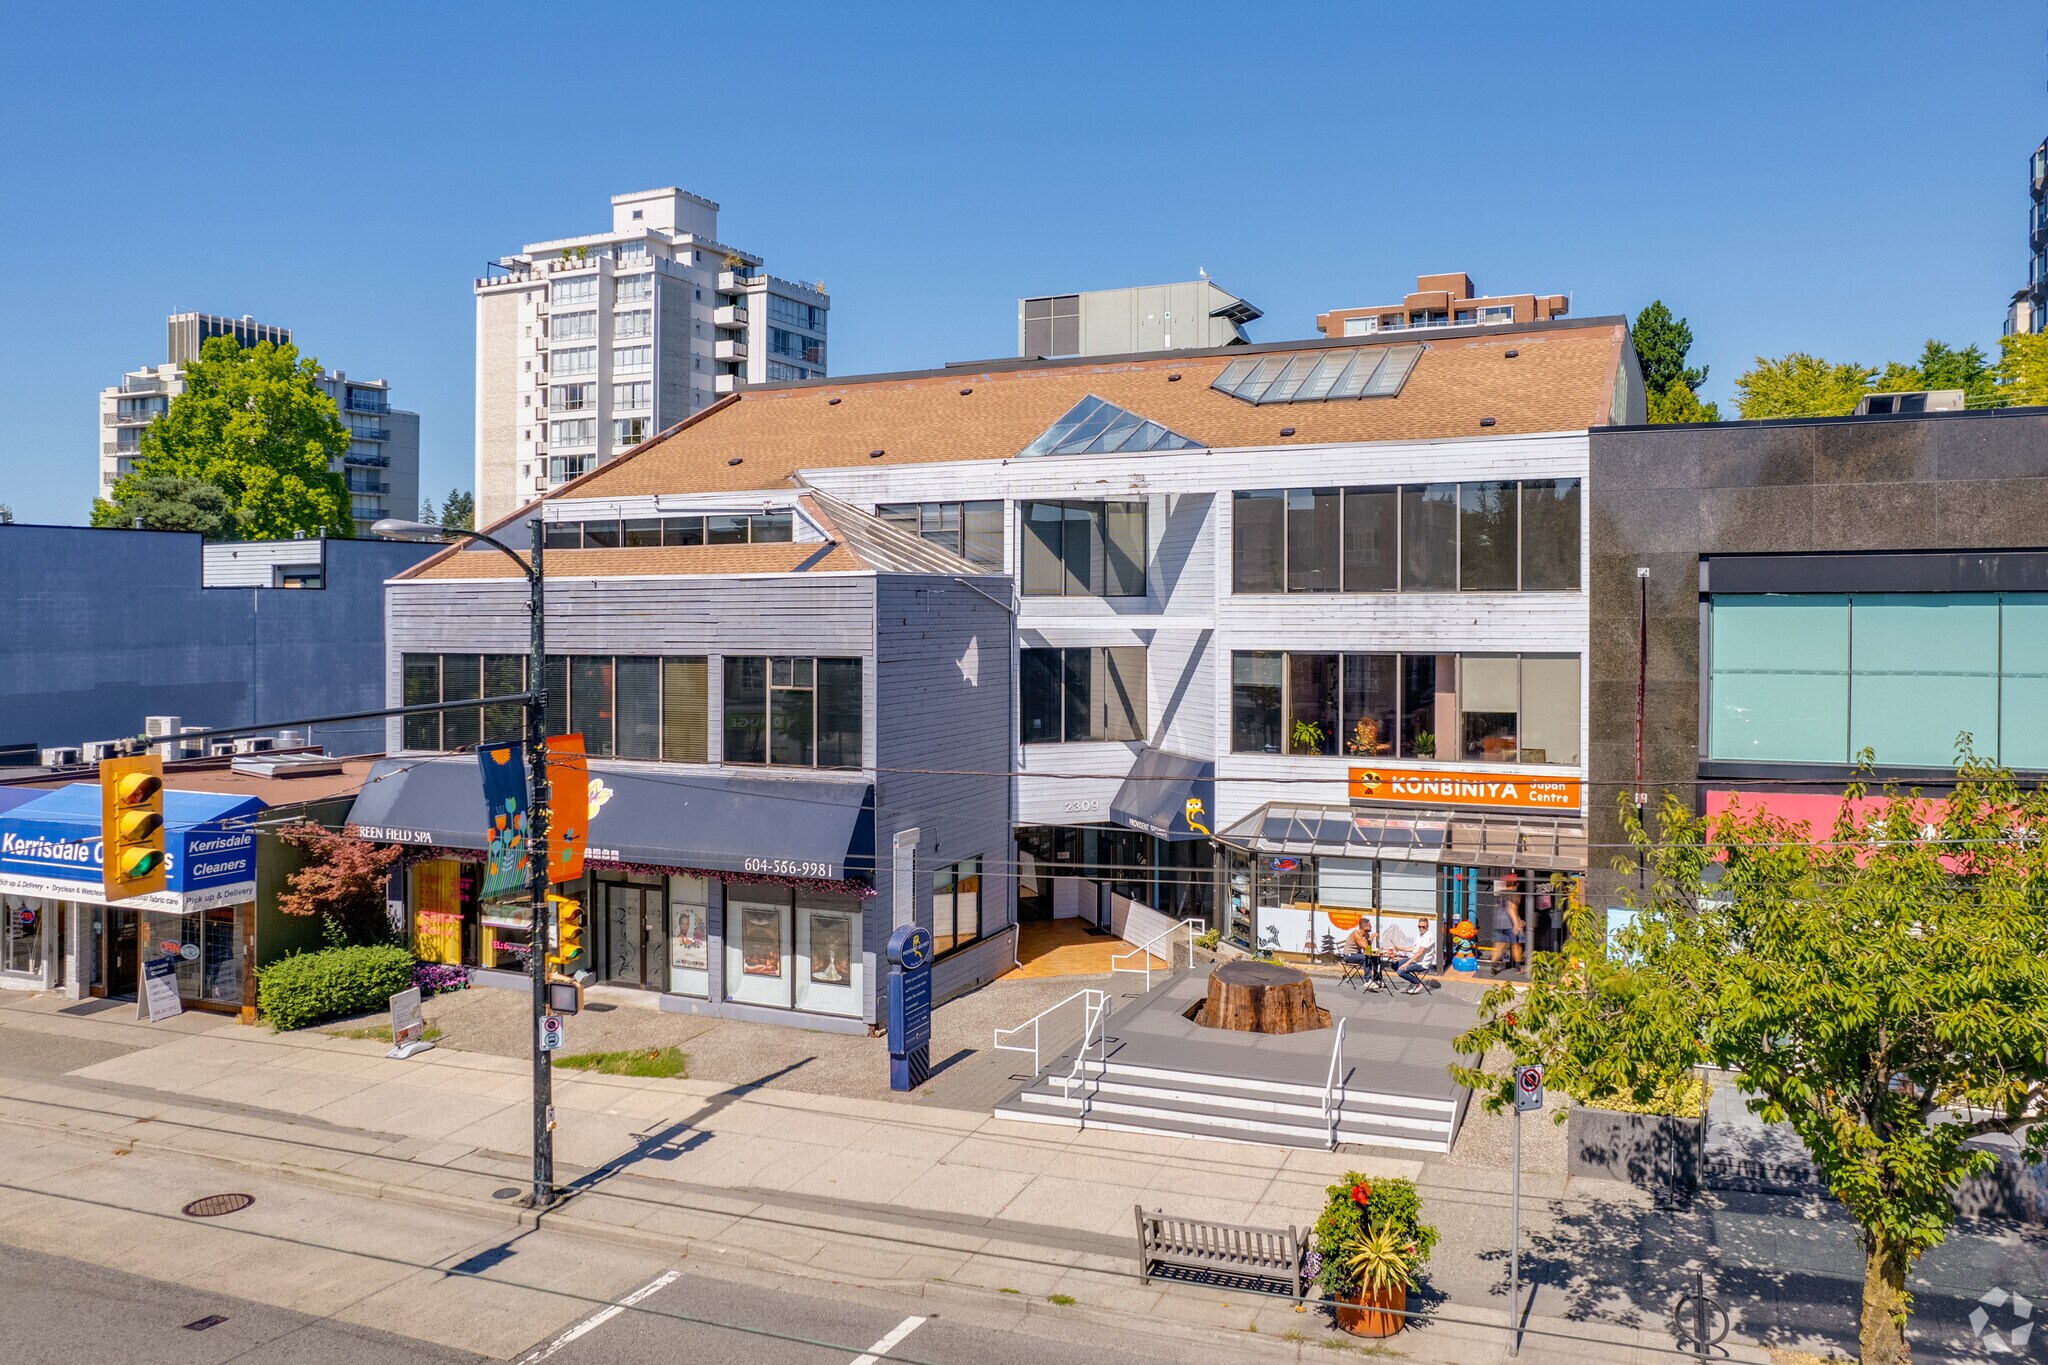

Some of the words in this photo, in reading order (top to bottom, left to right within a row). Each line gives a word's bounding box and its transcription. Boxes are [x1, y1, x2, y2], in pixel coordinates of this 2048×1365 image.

[1391, 775, 1518, 799] KONBINIYA
[1529, 779, 1566, 792] Japan
[1529, 790, 1569, 803] Centre
[1064, 800, 1099, 814] 2309
[359, 826, 383, 839] REEN
[386, 828, 412, 841] FIELD
[414, 831, 432, 844] SPA
[2, 832, 89, 862] Kerrisdale
[188, 833, 251, 853] Kerrisdale
[193, 859, 247, 876] Cleaners
[22, 881, 43, 891] Delivery
[52, 884, 75, 893] Dryclean
[149, 895, 165, 904] fabric
[186, 895, 202, 905] Pick
[204, 894, 215, 903] up
[217, 891, 222, 899] &
[224, 887, 253, 898] Delivery
